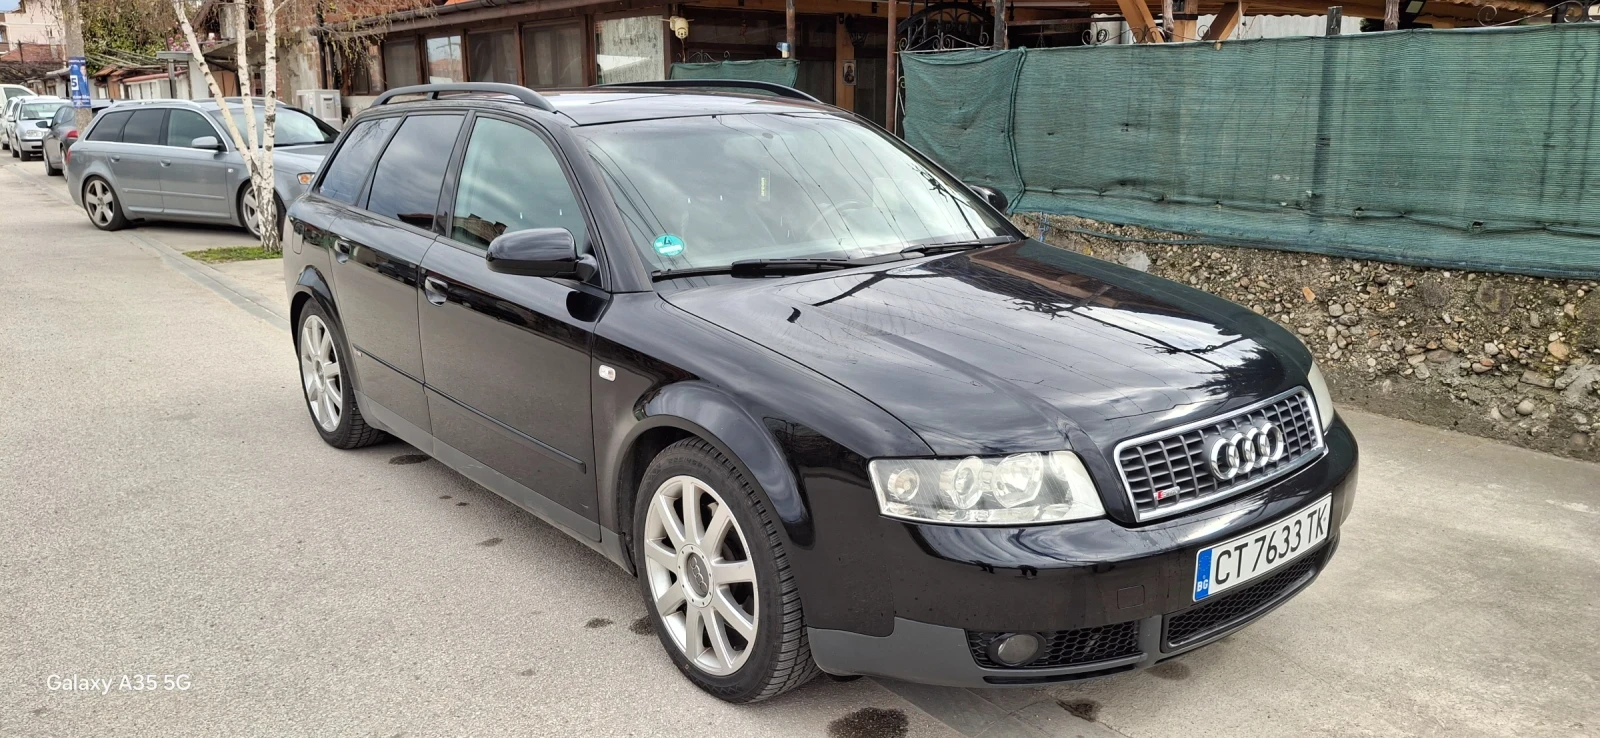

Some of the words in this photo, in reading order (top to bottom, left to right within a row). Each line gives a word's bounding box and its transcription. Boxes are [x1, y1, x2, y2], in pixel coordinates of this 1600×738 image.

[1215, 543, 1249, 585] CT
[1252, 519, 1302, 573] 7633
[1307, 503, 1328, 544] TK
[1197, 580, 1209, 592] BG
